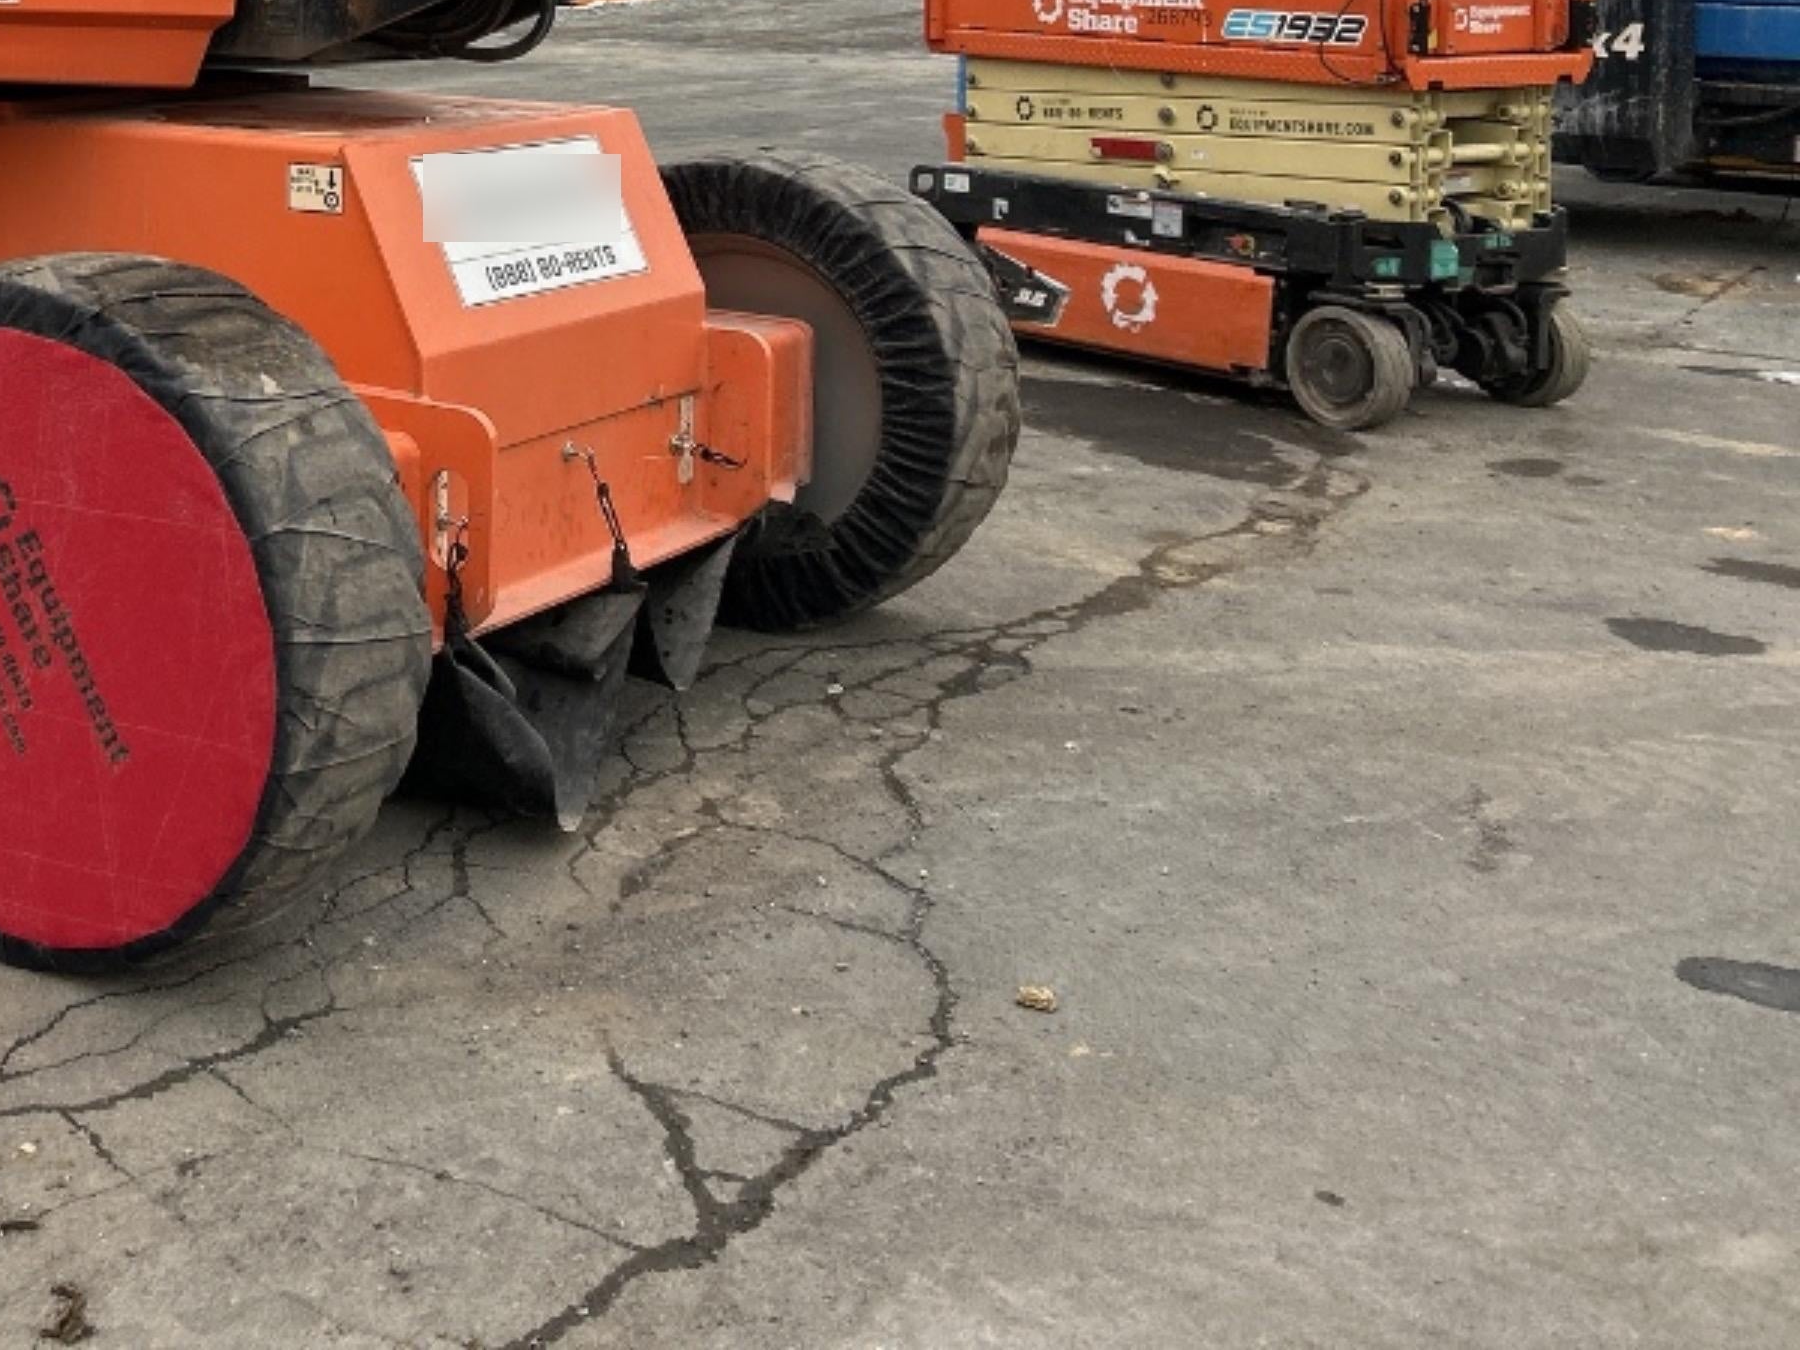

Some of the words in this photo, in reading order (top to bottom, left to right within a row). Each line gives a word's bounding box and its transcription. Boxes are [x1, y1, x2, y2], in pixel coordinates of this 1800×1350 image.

[1066, 8, 1138, 35] Share
[1222, 8, 1367, 46] ES1932
[485, 257, 538, 291] (888)
[536, 245, 618, 280] 80-RENTS
[16, 530, 129, 762] Equipment
